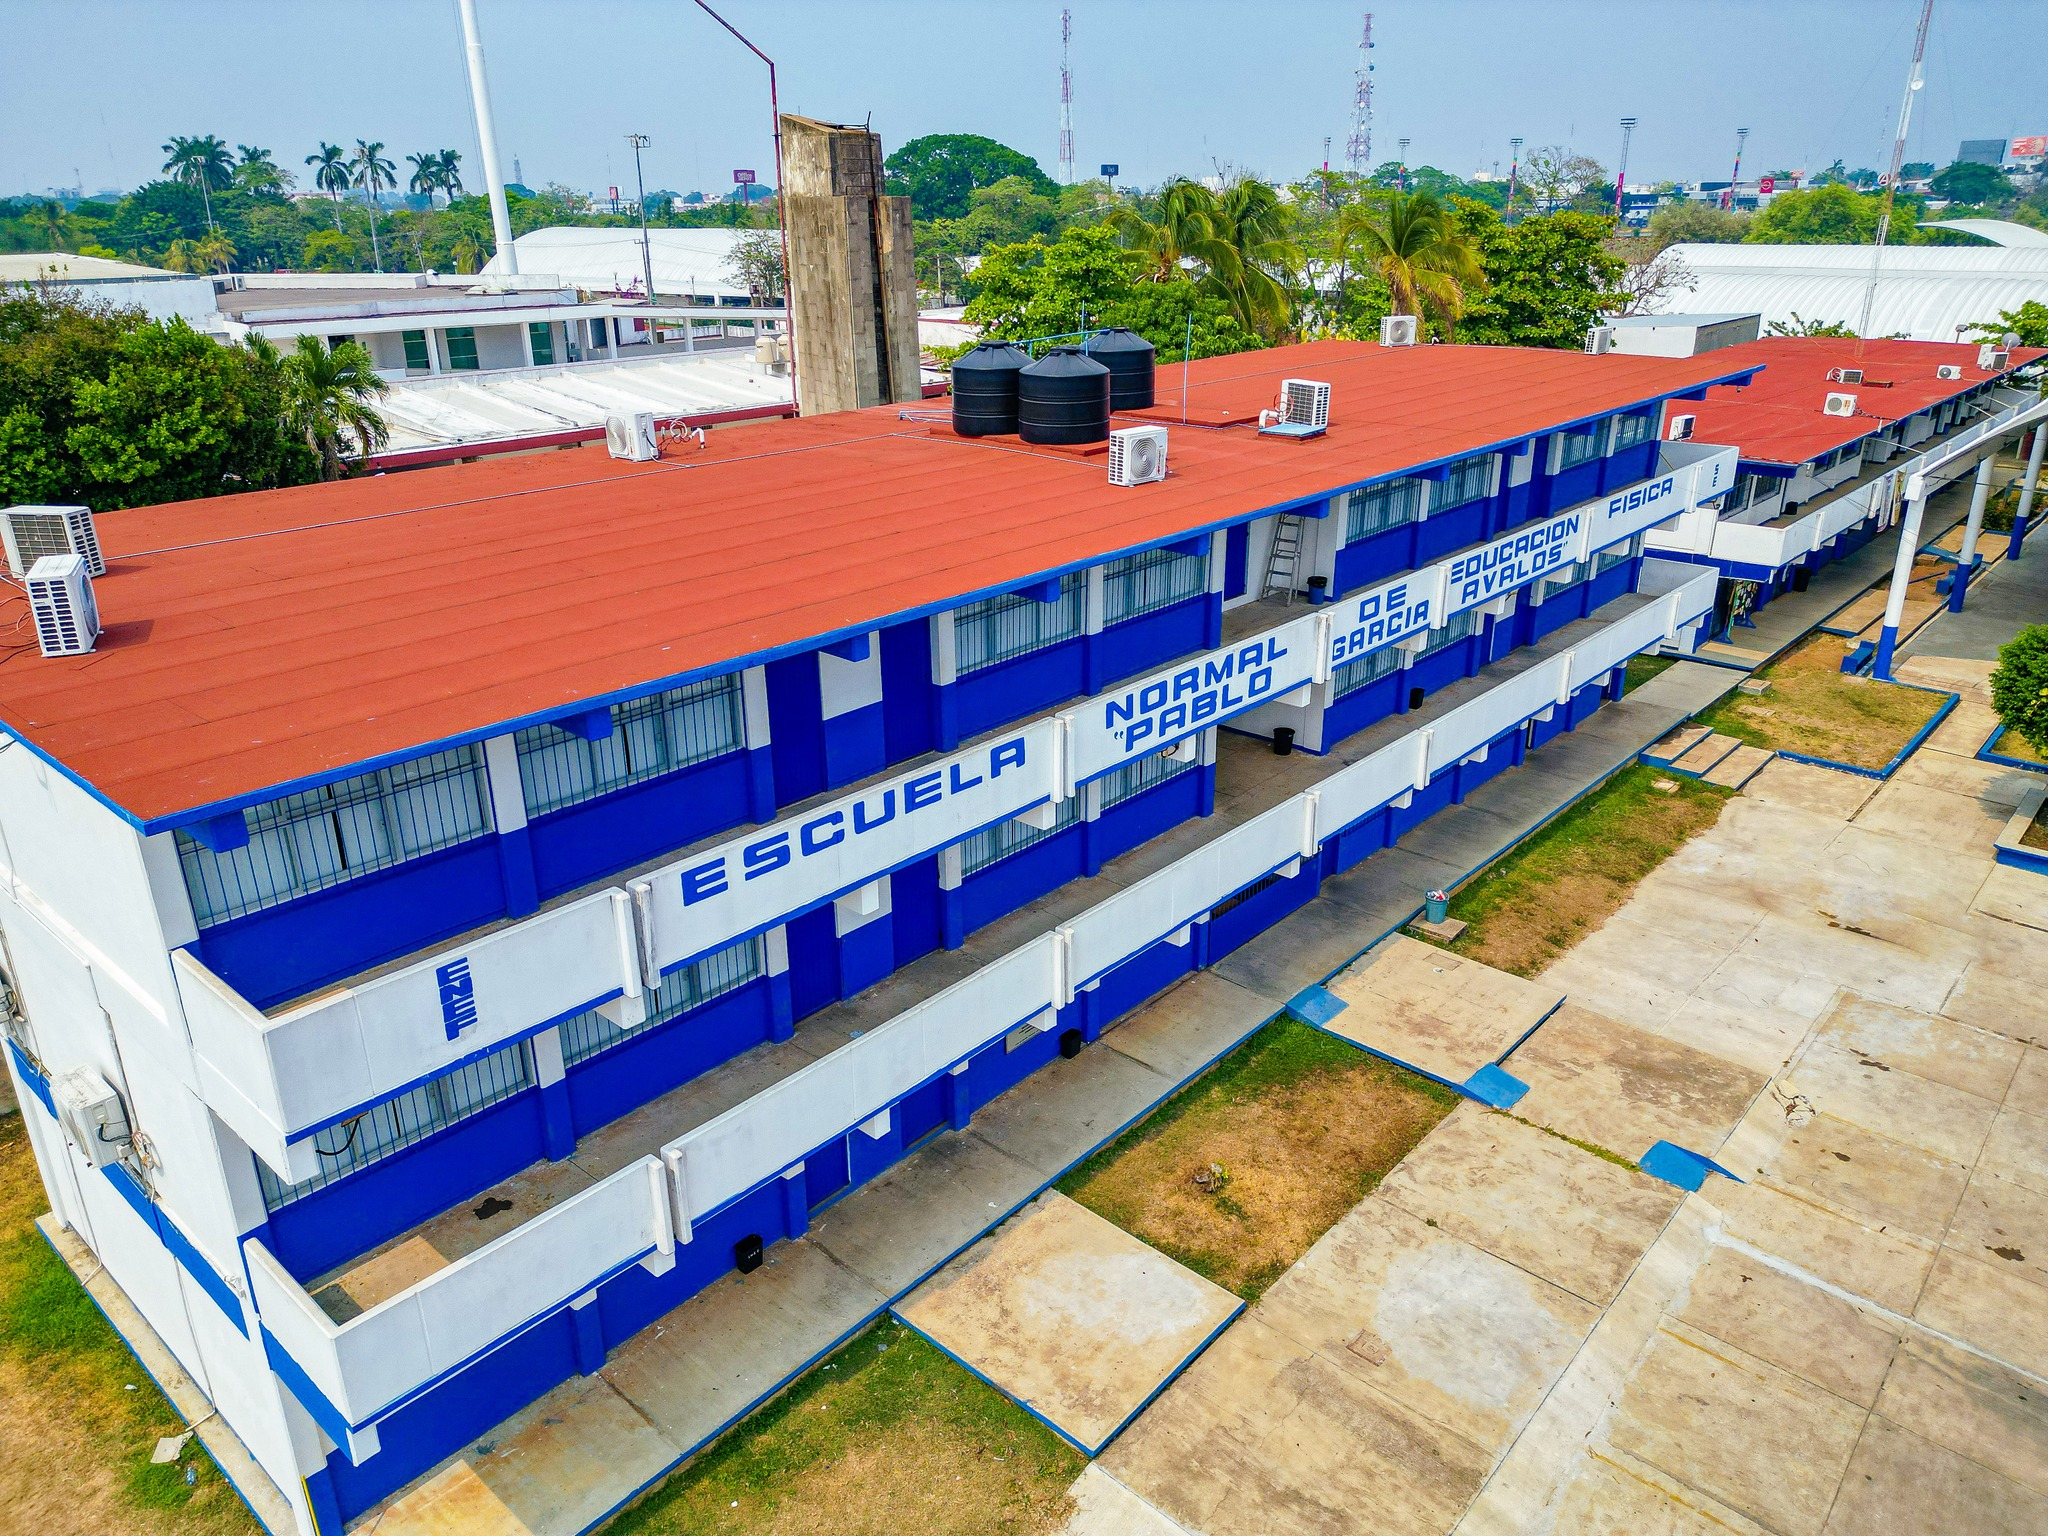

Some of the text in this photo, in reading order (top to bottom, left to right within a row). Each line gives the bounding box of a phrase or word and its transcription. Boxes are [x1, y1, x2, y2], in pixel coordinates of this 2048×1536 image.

[1332, 599, 1430, 661] GARCIA
[681, 477, 1674, 907] ESCUELA NORMAL DE EDUCACION FISICA
[435, 956, 478, 1041] ENEF
